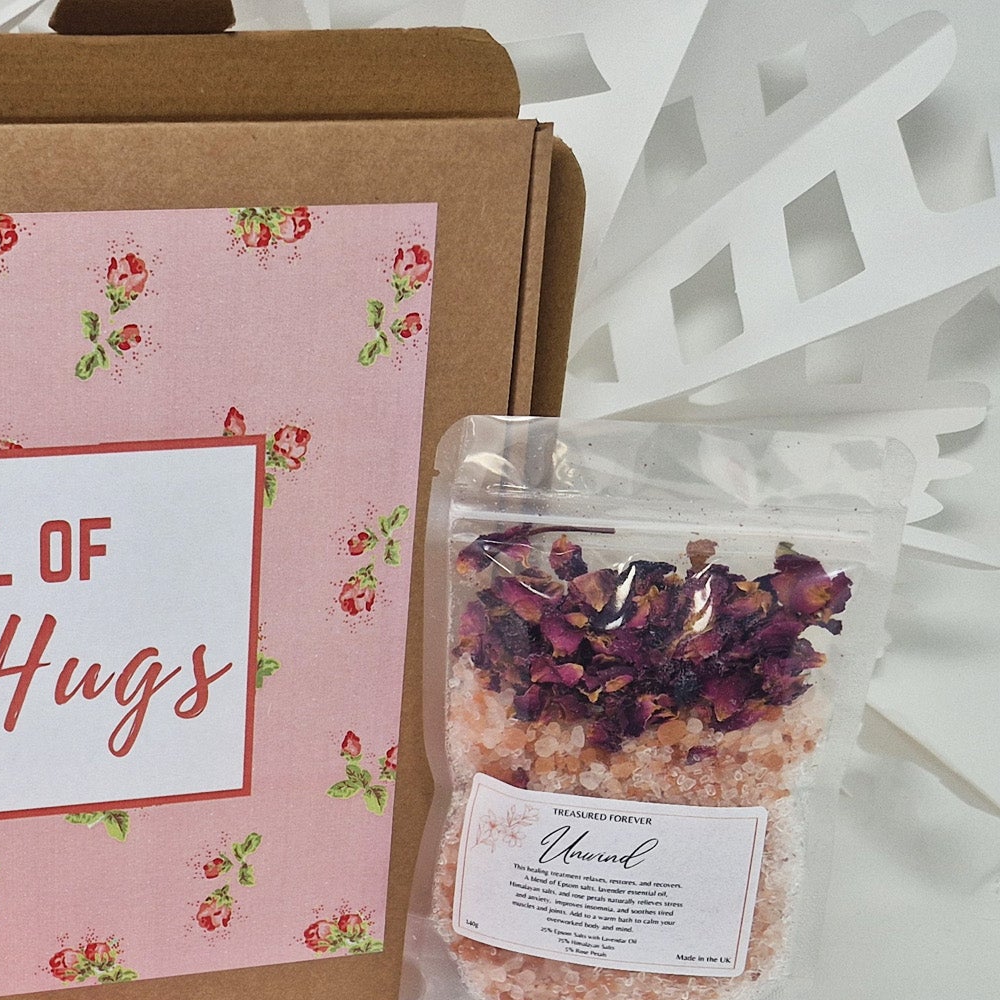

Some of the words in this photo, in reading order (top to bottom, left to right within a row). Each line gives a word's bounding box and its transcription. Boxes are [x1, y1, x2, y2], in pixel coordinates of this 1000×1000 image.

[39, 517, 112, 583] OF
[553, 808, 607, 821] TREASURED
[609, 814, 652, 825] FOREVER
[538, 826, 659, 869] Unwind
[513, 863, 526, 871] This
[527, 866, 548, 876] healing
[550, 870, 581, 880] treatment
[509, 880, 540, 891] Himalayan
[598, 886, 626, 894] lavender
[512, 901, 535, 909] muscles
[554, 900, 583, 908] improves
[546, 917, 583, 926] overworked
